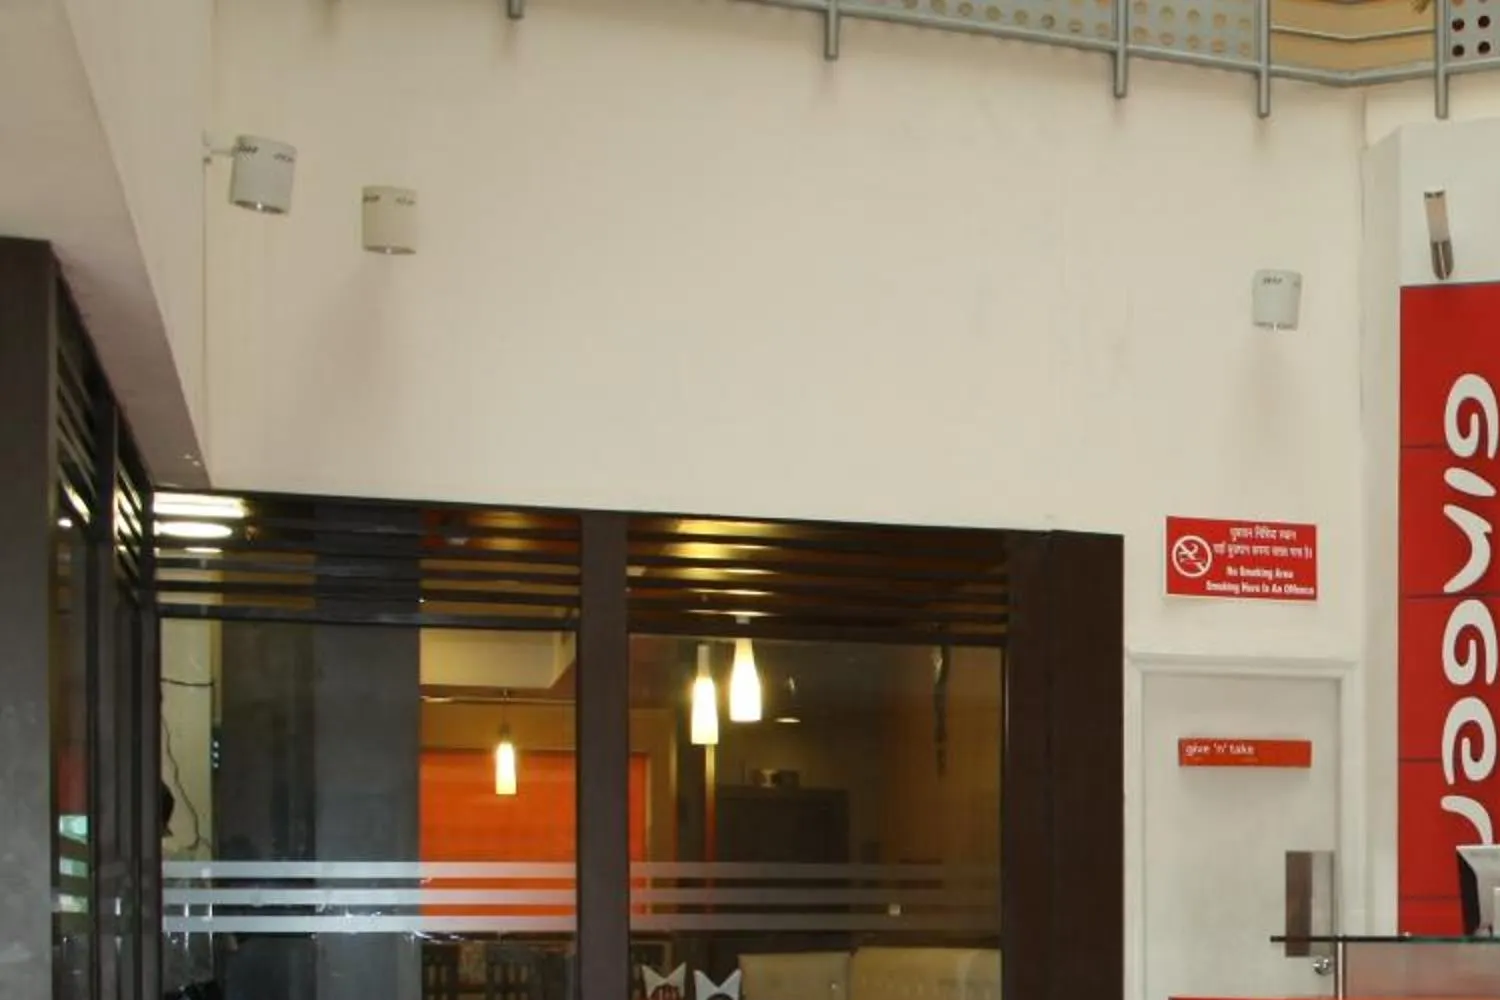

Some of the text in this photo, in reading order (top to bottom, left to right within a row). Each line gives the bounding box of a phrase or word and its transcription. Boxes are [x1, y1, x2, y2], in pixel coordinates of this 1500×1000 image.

[1226, 565, 1294, 580] No Smoking Area
[1206, 580, 1240, 594] Smoking
